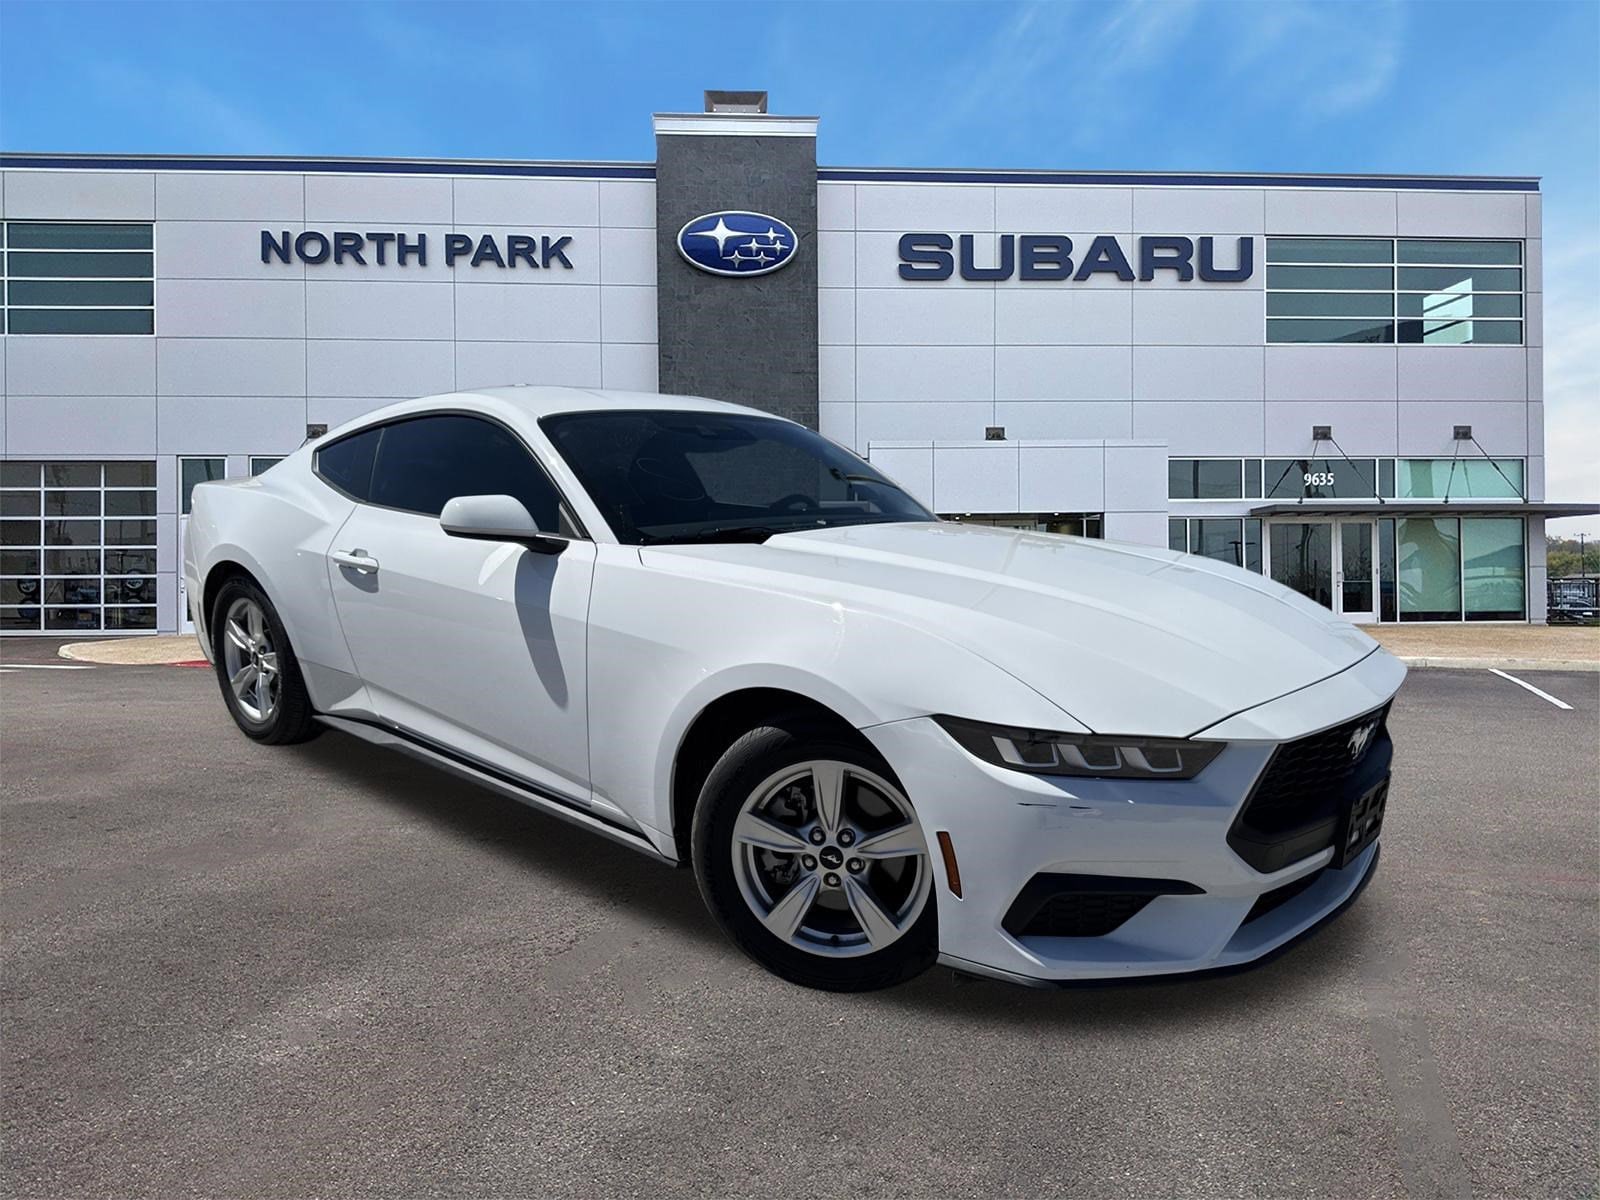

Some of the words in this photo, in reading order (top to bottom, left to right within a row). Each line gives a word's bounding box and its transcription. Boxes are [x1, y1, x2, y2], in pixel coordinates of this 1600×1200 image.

[261, 230, 427, 267] NORTH
[445, 234, 573, 269] PARK
[898, 233, 1253, 283] SUBARU
[1303, 472, 1335, 486] 9635
